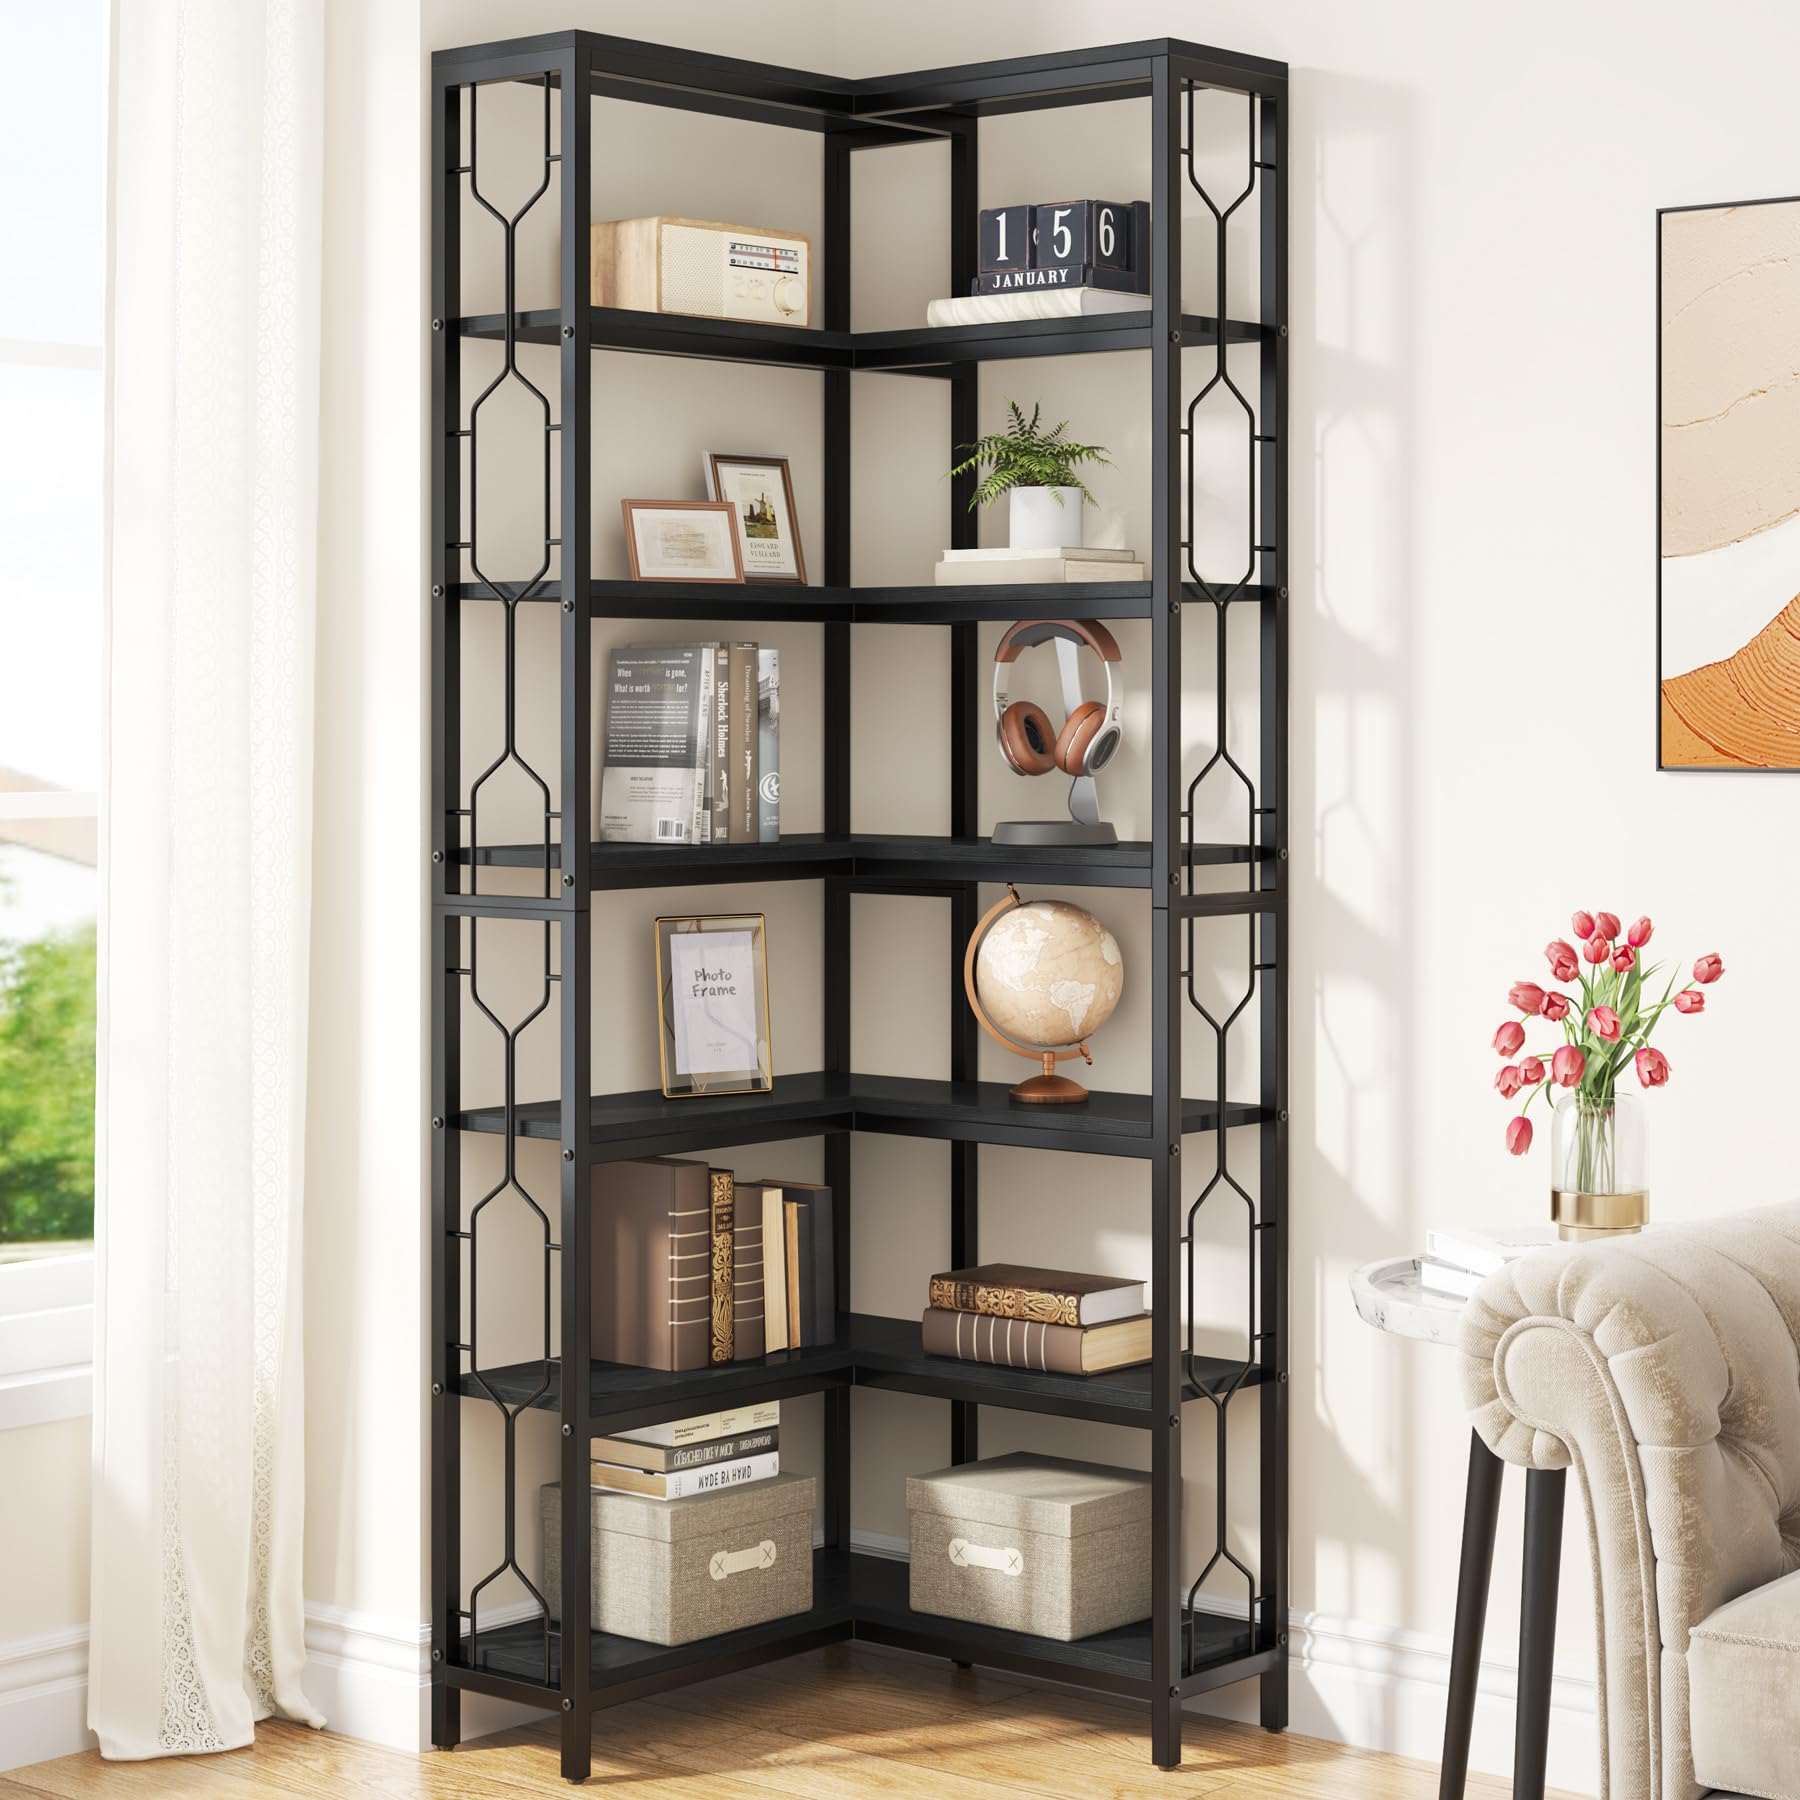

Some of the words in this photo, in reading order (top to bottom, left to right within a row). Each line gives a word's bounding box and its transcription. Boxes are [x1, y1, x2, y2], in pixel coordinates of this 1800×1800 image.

[996, 212, 1009, 261] 1
[1053, 208, 1072, 258] 5
[1099, 208, 1115, 257] 6
[992, 268, 1069, 289] JANUARY
[617, 668, 632, 678] When
[743, 665, 752, 702] Dreaming
[614, 683, 628, 693] What
[635, 683, 651, 693] worth
[676, 683, 688, 693] for?
[717, 681, 728, 722] Sherlock
[744, 703, 752, 712] of
[744, 712, 752, 742] Sweden
[717, 724, 728, 758] Holmes
[694, 968, 732, 981] Photo
[692, 984, 736, 997] Frame
